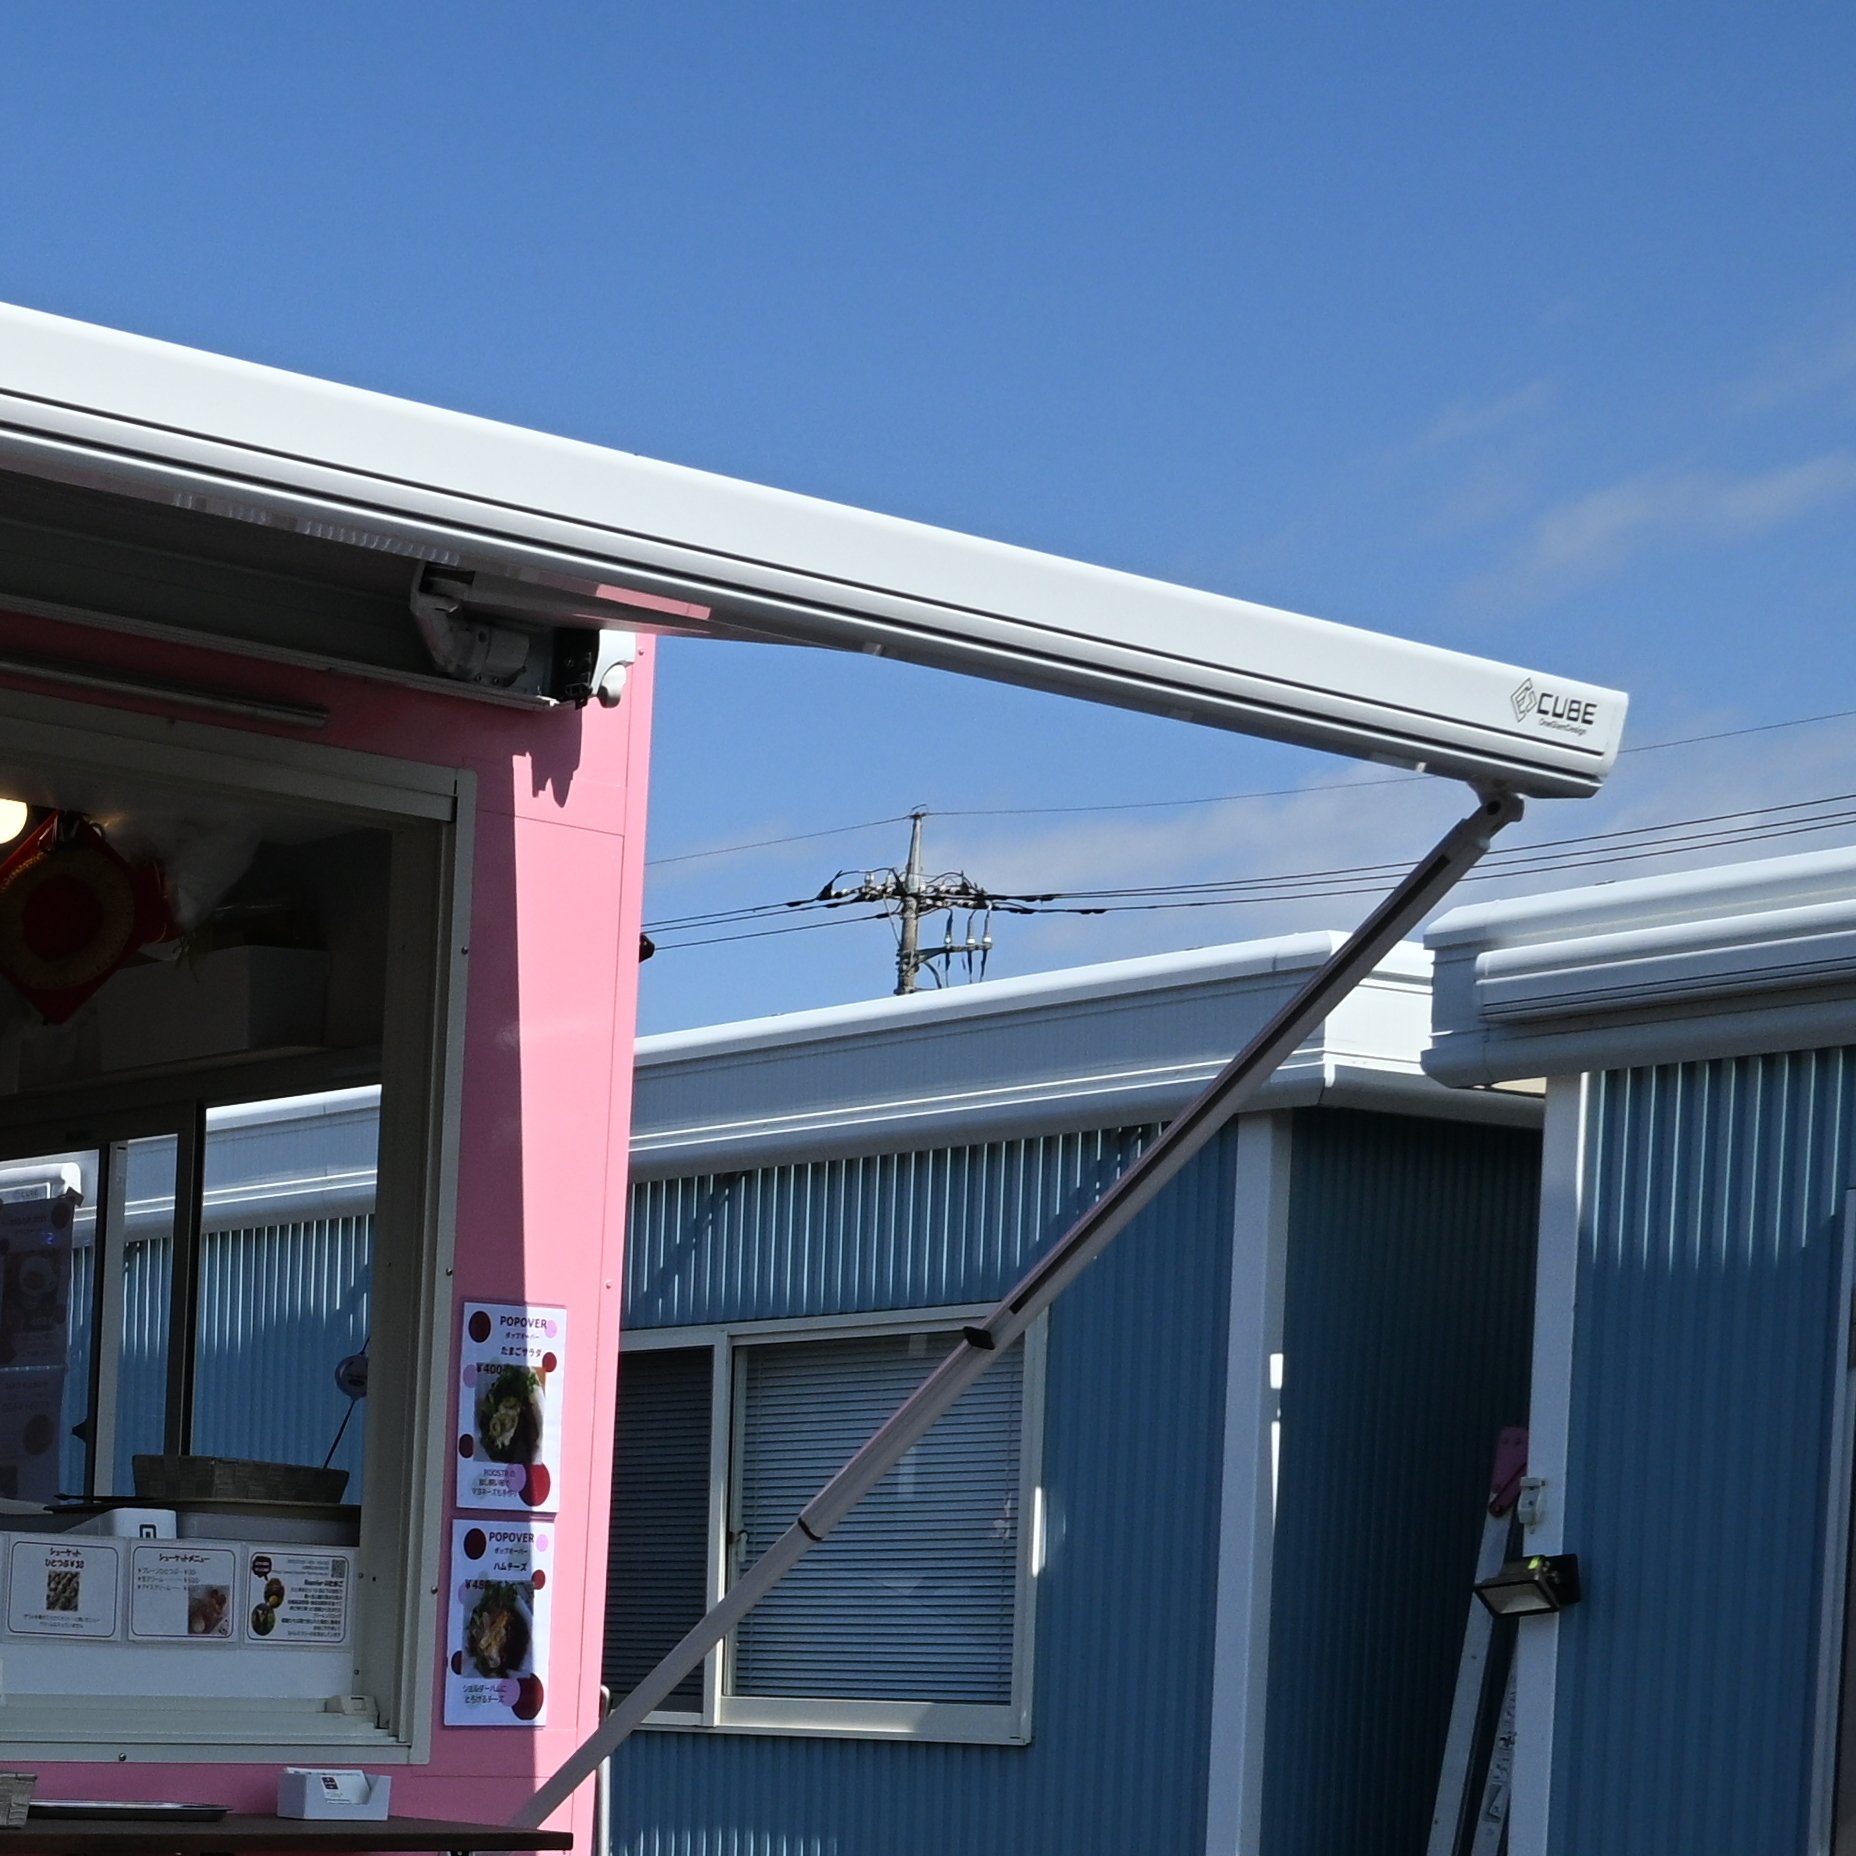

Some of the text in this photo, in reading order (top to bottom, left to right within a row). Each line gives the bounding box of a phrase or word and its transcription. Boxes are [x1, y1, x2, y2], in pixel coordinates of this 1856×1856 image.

[1536, 692, 1598, 725] CUBE
[500, 1315, 548, 1329] POPOVER
[500, 1346, 543, 1358] たまごサラダ
[488, 1531, 535, 1543] POPOVER
[493, 1561, 528, 1572] ハムチーズ
